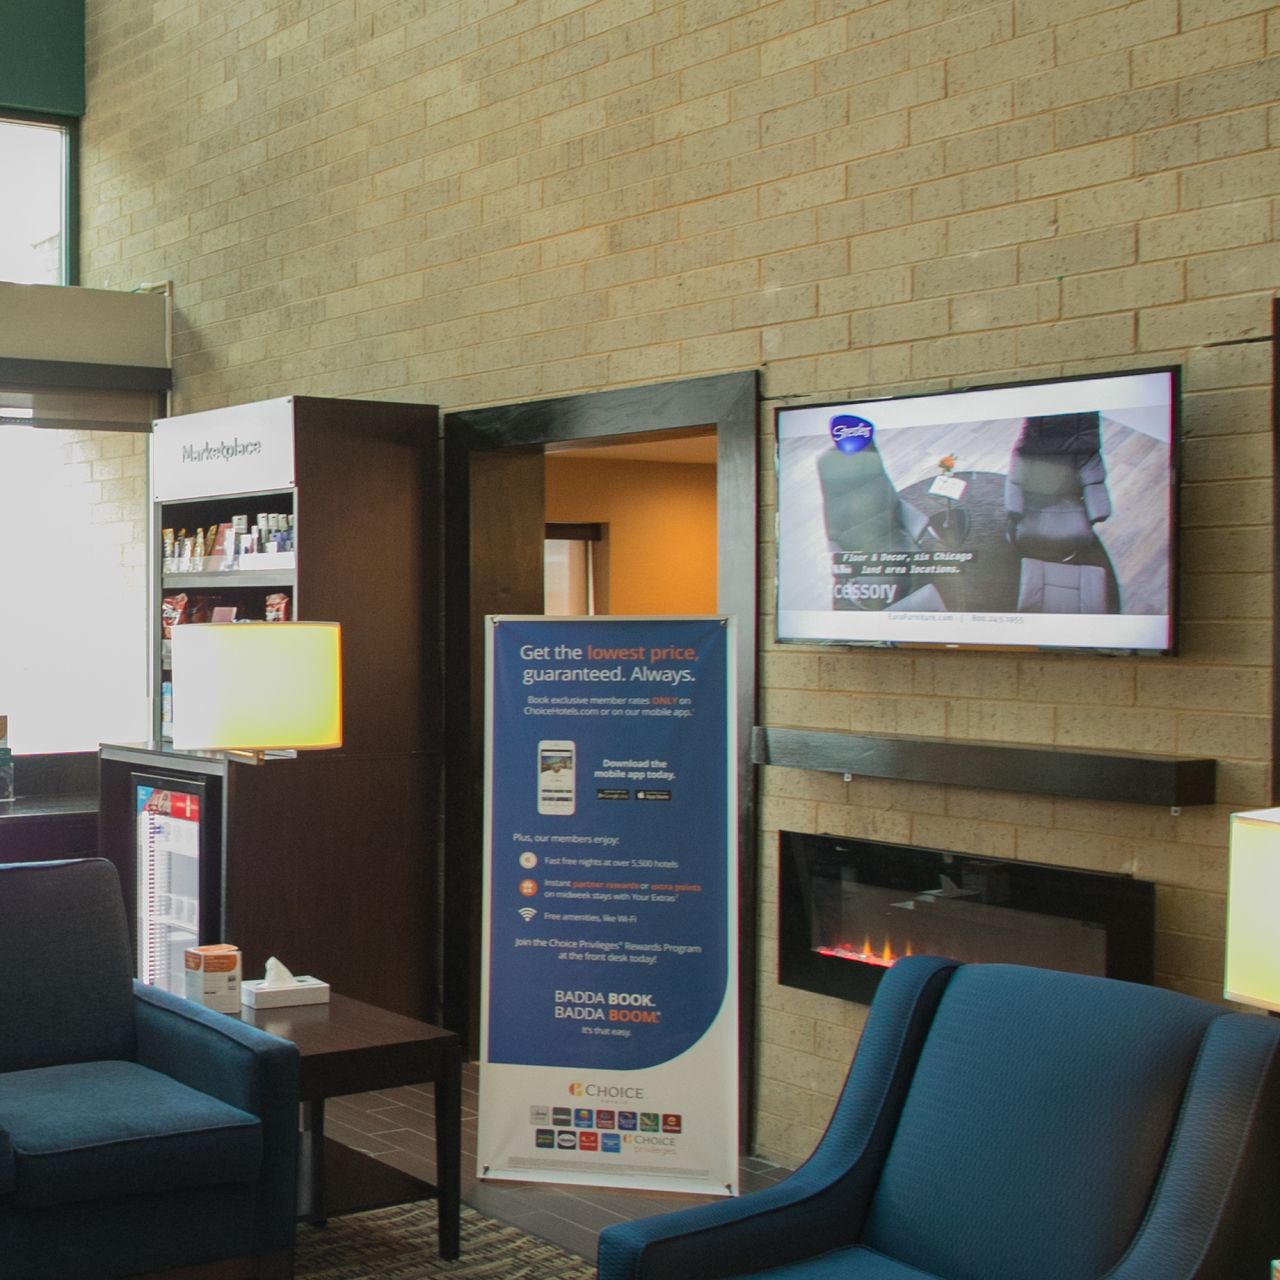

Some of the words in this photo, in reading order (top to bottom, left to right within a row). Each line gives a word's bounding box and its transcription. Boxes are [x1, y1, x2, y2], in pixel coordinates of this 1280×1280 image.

[182, 437, 261, 463] Marketplace
[842, 552, 868, 562] Floor
[880, 552, 911, 563] Decor,
[913, 552, 930, 561] six
[933, 552, 973, 562] Chicago
[861, 565, 882, 574] land
[885, 566, 907, 574] area
[909, 565, 961, 574] locations.
[520, 645, 551, 660] Get
[554, 644, 583, 660] the
[587, 645, 645, 660] lowest
[650, 645, 700, 664] price,
[522, 666, 626, 685] guaranteed.
[630, 666, 696, 685] Always.
[527, 695, 549, 704] Book
[550, 696, 588, 705] exclusive
[590, 696, 626, 705] member
[628, 696, 650, 705] rates
[651, 696, 678, 705] ONLY
[679, 697, 691, 705] on
[523, 706, 599, 715] ChoiceHotels.com
[600, 707, 610, 716] or
[611, 707, 623, 716] on
[624, 707, 640, 716] our
[641, 707, 672, 716] mobile
[602, 759, 650, 768] Download
[651, 759, 668, 768] the
[594, 769, 626, 778] mobile
[627, 771, 646, 780] app
[646, 770, 676, 781] today.
[513, 833, 532, 842] Plus,
[551, 834, 592, 844] members
[544, 856, 561, 864] Fast
[562, 857, 577, 865] free
[578, 858, 602, 868] nights
[654, 860, 679, 869] hotels
[544, 879, 571, 887] Instant
[556, 891, 591, 899] midweek
[592, 892, 613, 902] stays
[613, 893, 631, 901] with
[632, 893, 650, 902] Your
[544, 912, 562, 920] Free
[602, 914, 616, 922] like
[618, 915, 638, 923] Wi-Fi
[515, 938, 532, 947] Join
[533, 938, 548, 947] the
[549, 938, 578, 948] Choice
[625, 942, 662, 952] Rewards
[663, 943, 702, 955] Program
[558, 952, 567, 960] at
[568, 952, 583, 960] the
[584, 952, 606, 962] front
[607, 953, 628, 962] desk
[629, 954, 657, 965] today!
[554, 990, 606, 1004] BADDA
[608, 992, 656, 1007] BOOK.
[554, 1006, 606, 1020] BADDA
[593, 1026, 610, 1036] that
[611, 1028, 632, 1038] easy.
[585, 1084, 644, 1099] CHOICE
[634, 1134, 676, 1146] CHOICE
